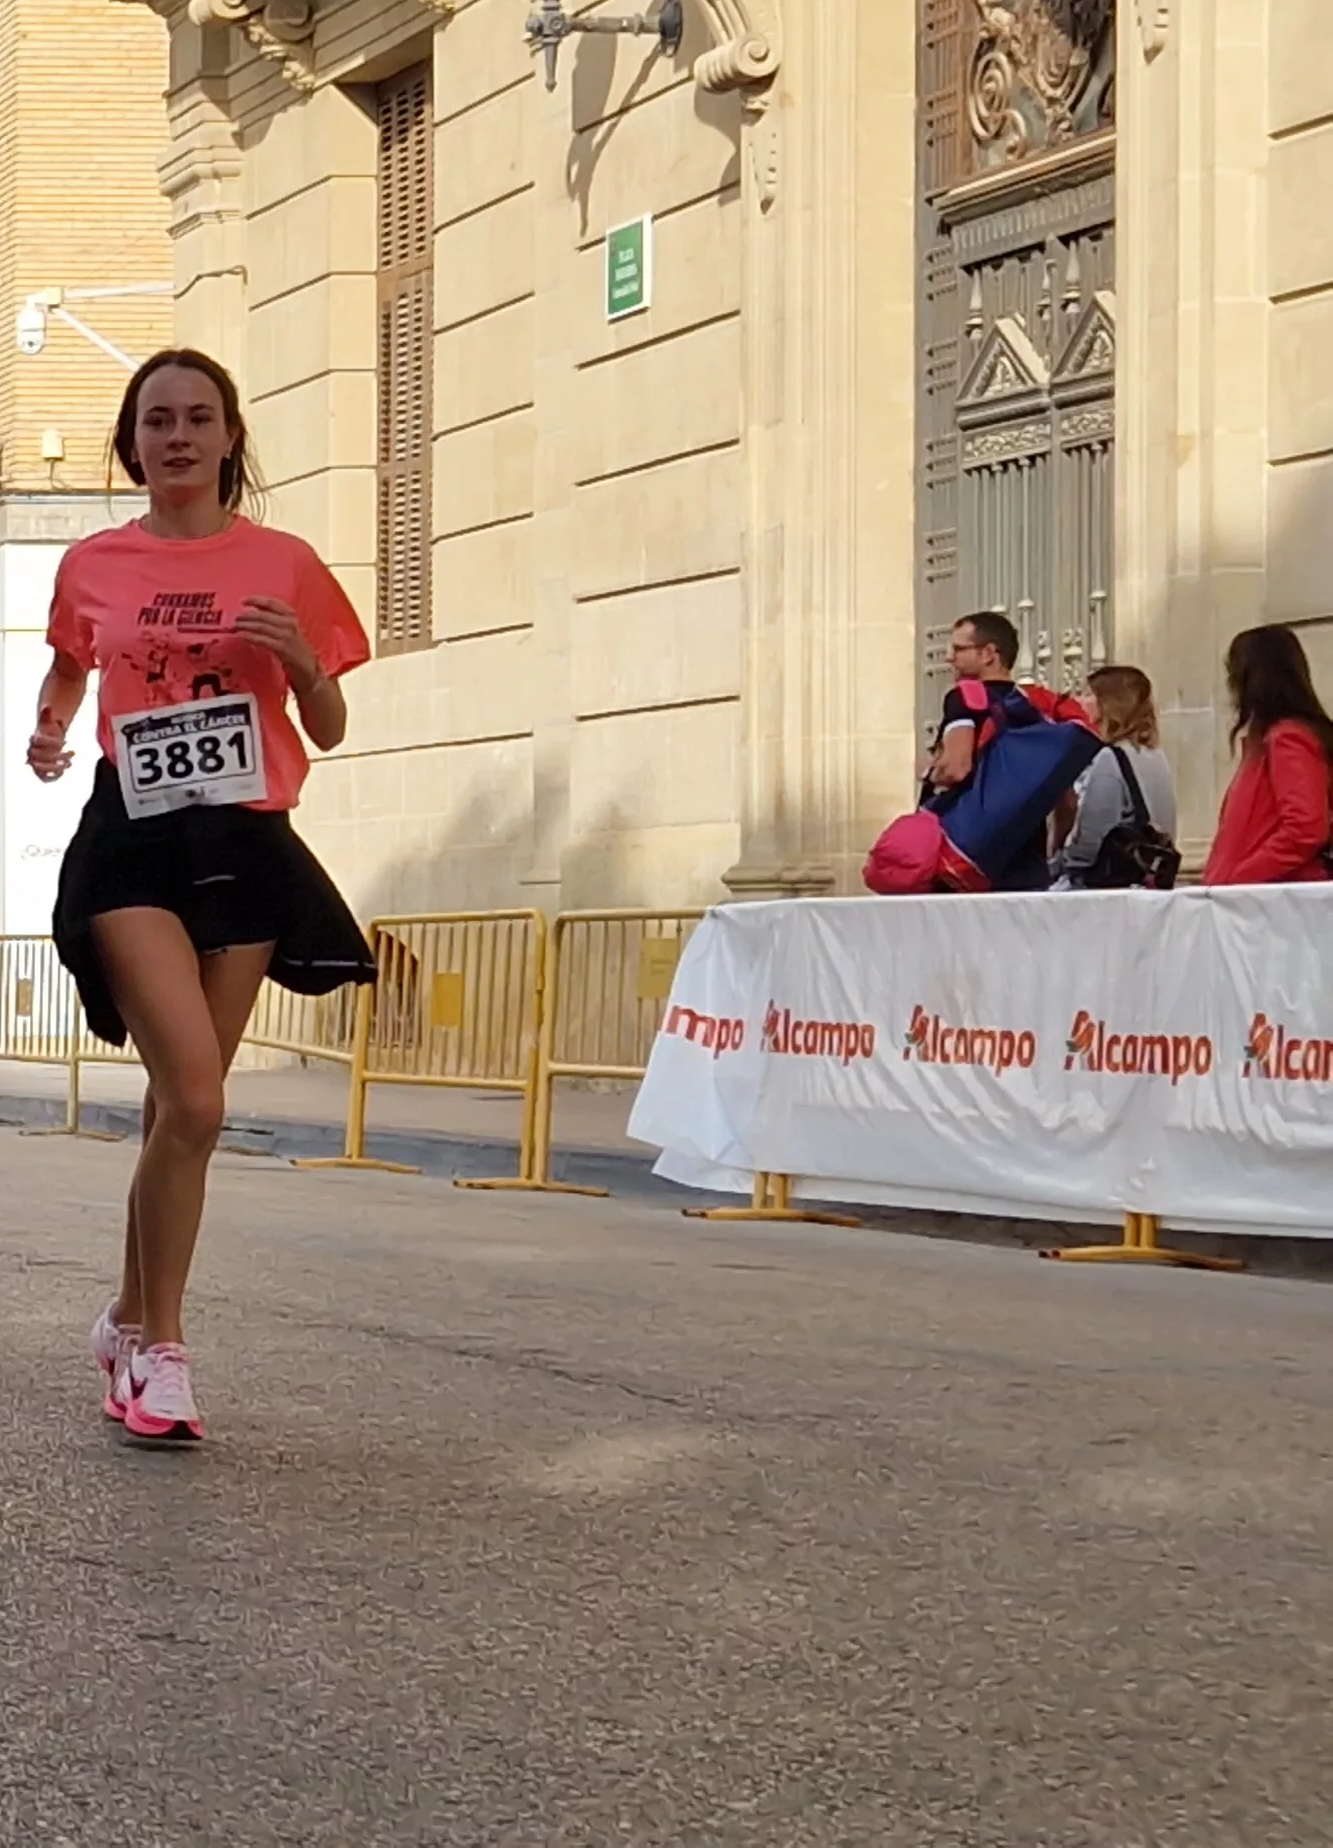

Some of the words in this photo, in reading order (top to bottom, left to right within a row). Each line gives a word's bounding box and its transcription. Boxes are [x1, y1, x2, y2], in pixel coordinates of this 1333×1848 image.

[135, 730, 248, 786] 3881
[760, 998, 875, 1067] Alcampo
[903, 1004, 1036, 1078] Alcampo
[1063, 1010, 1212, 1087] Alcampo
